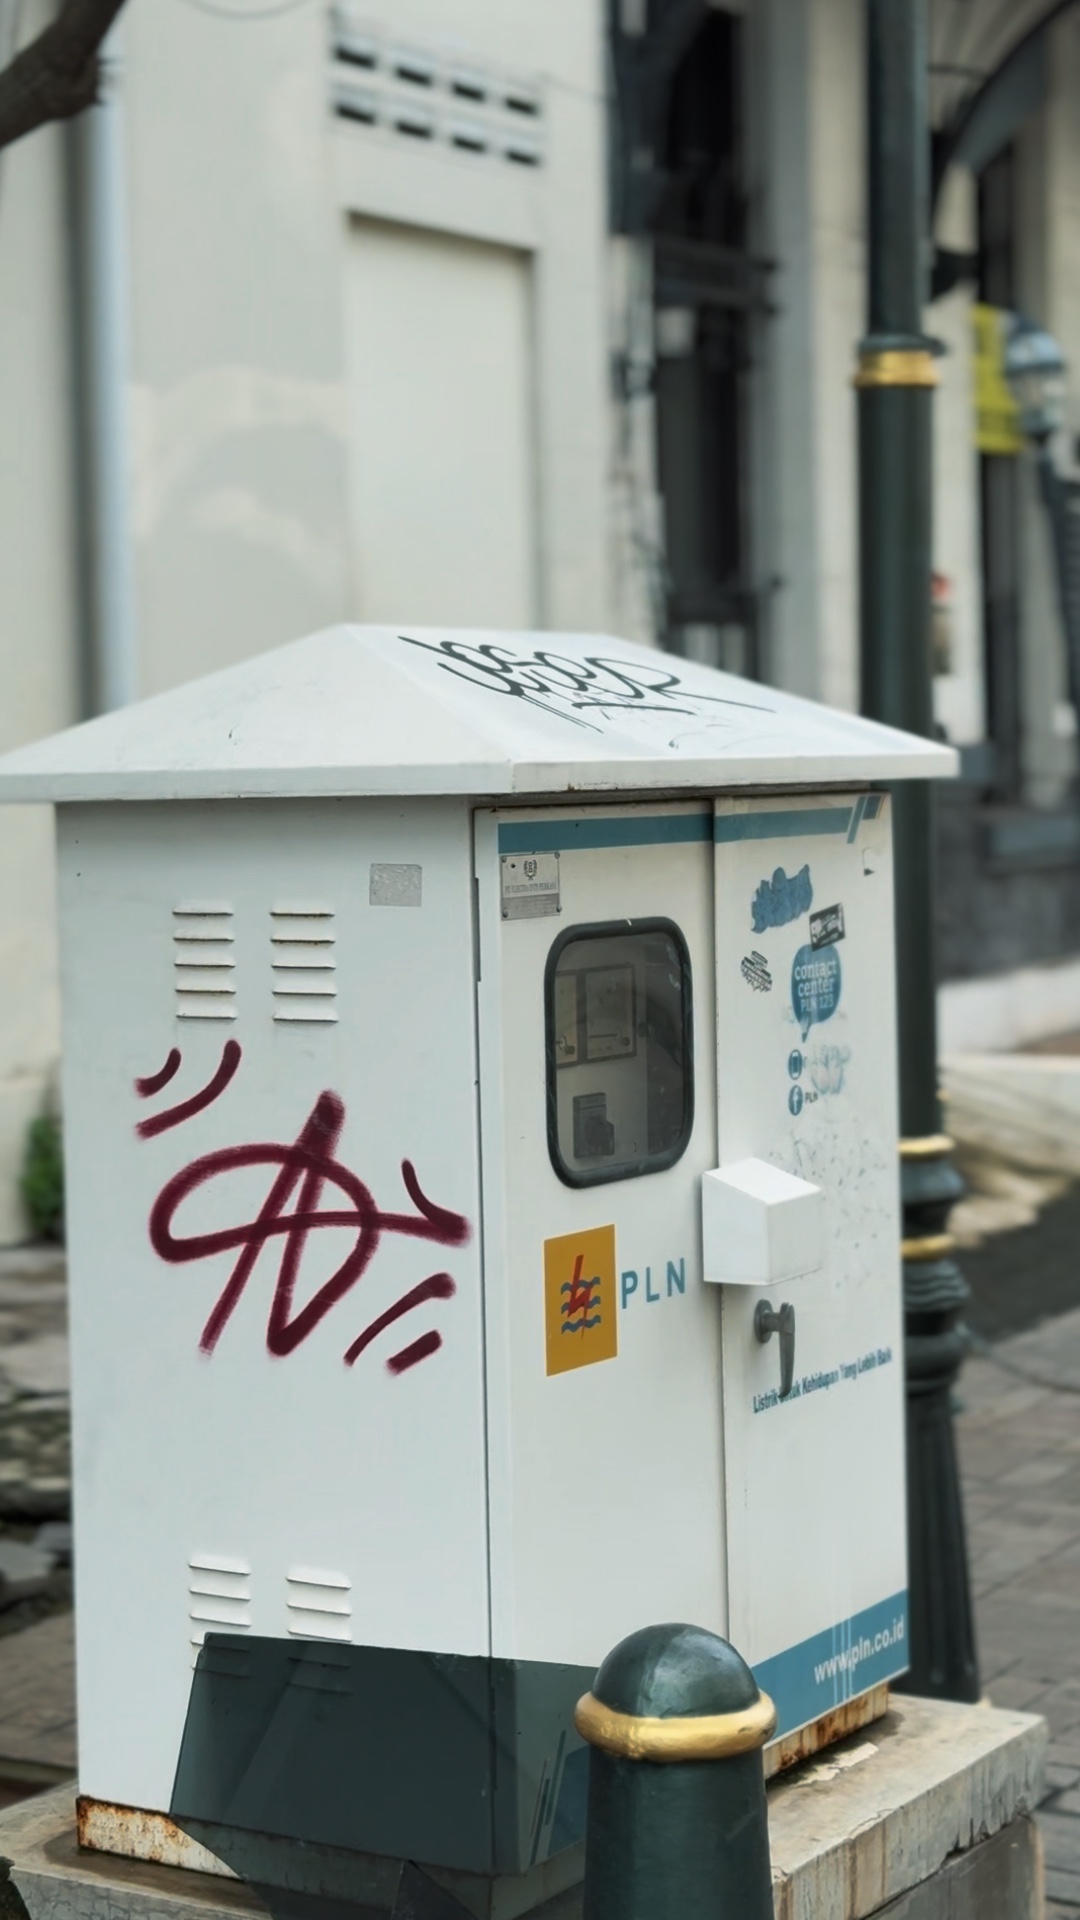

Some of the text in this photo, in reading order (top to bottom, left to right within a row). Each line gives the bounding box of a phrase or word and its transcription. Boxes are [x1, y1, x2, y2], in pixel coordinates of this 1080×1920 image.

[794, 959, 837, 980] contact
[798, 978, 834, 997] center
[800, 993, 834, 1012] PLN 123
[621, 1257, 685, 1309] PLN
[753, 1388, 778, 1414] Listrik
[802, 1371, 839, 1395] Kehidupan
[839, 1363, 857, 1381] Yang
[857, 1352, 876, 1374] Lebih
[877, 1346, 892, 1367] Baik
[814, 1614, 905, 1685] www.pln.co.id
